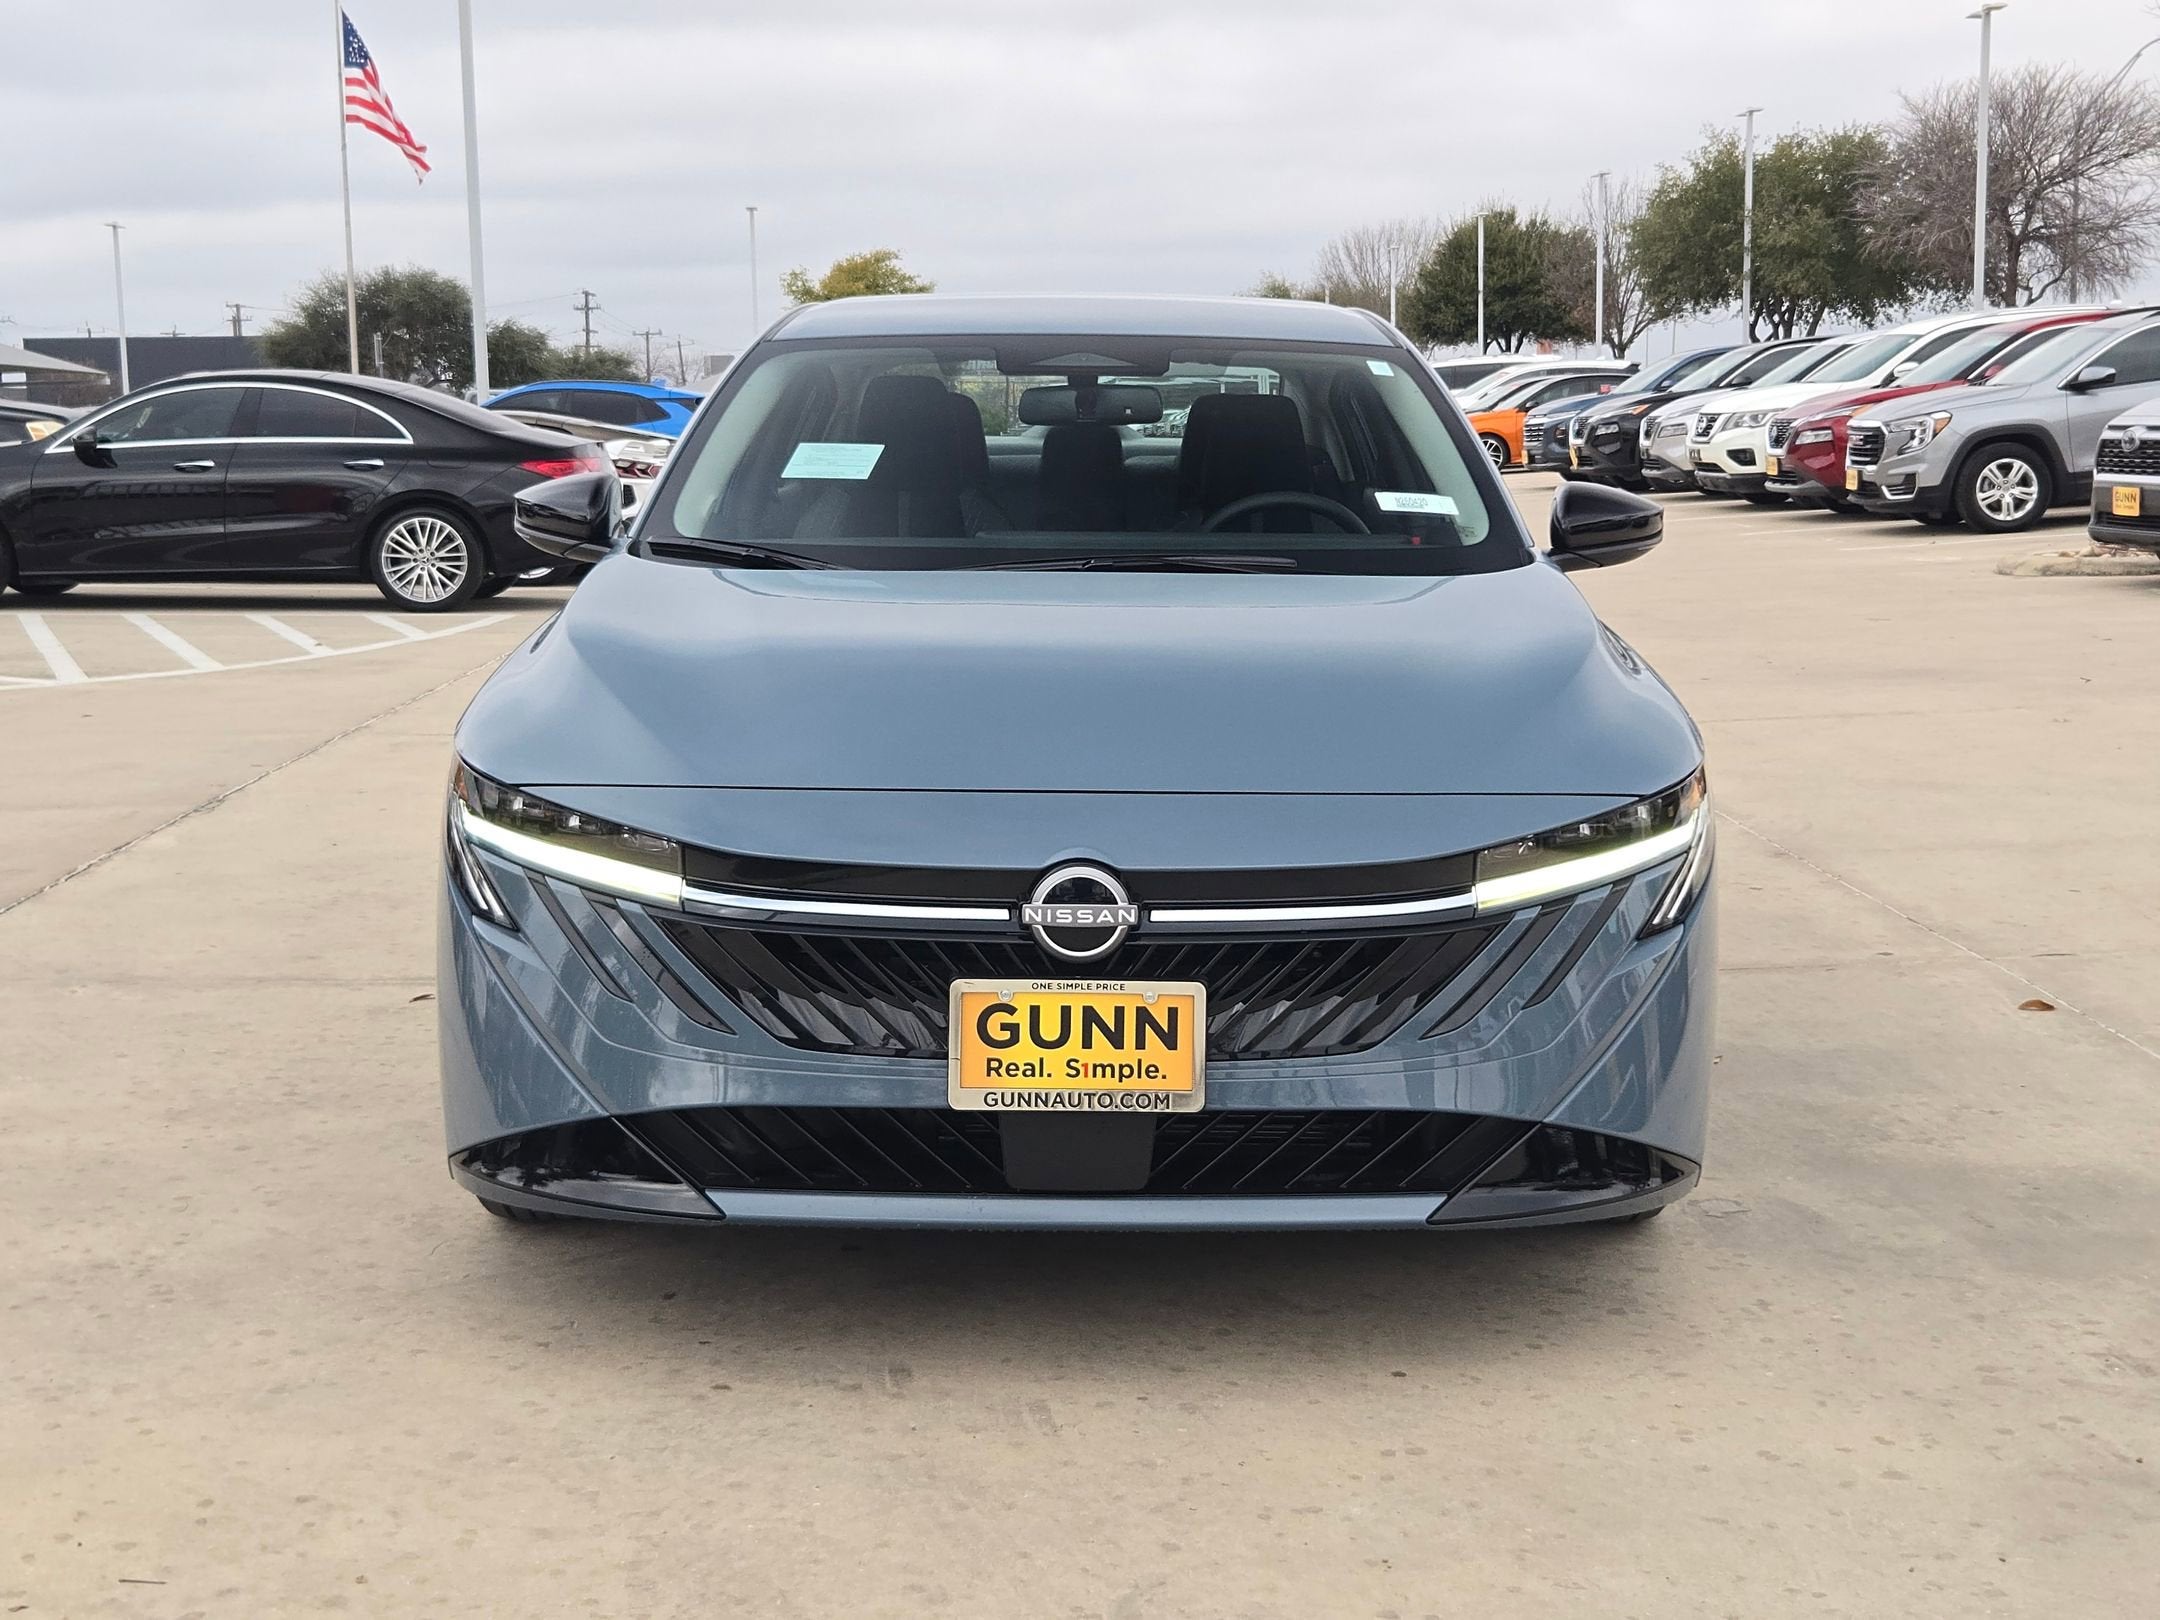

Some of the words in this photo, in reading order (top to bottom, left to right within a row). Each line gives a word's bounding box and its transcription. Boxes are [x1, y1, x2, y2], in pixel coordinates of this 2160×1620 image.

[1024, 907, 1137, 925] NISSAN
[1031, 982, 1054, 990] ONE
[1056, 982, 1093, 991] SIMPLE
[1095, 983, 1126, 991] PRICE
[976, 1002, 1179, 1051] GUNN
[985, 1057, 1053, 1078] Real.
[983, 1091, 1171, 1111] GUNNAUTO.COM
